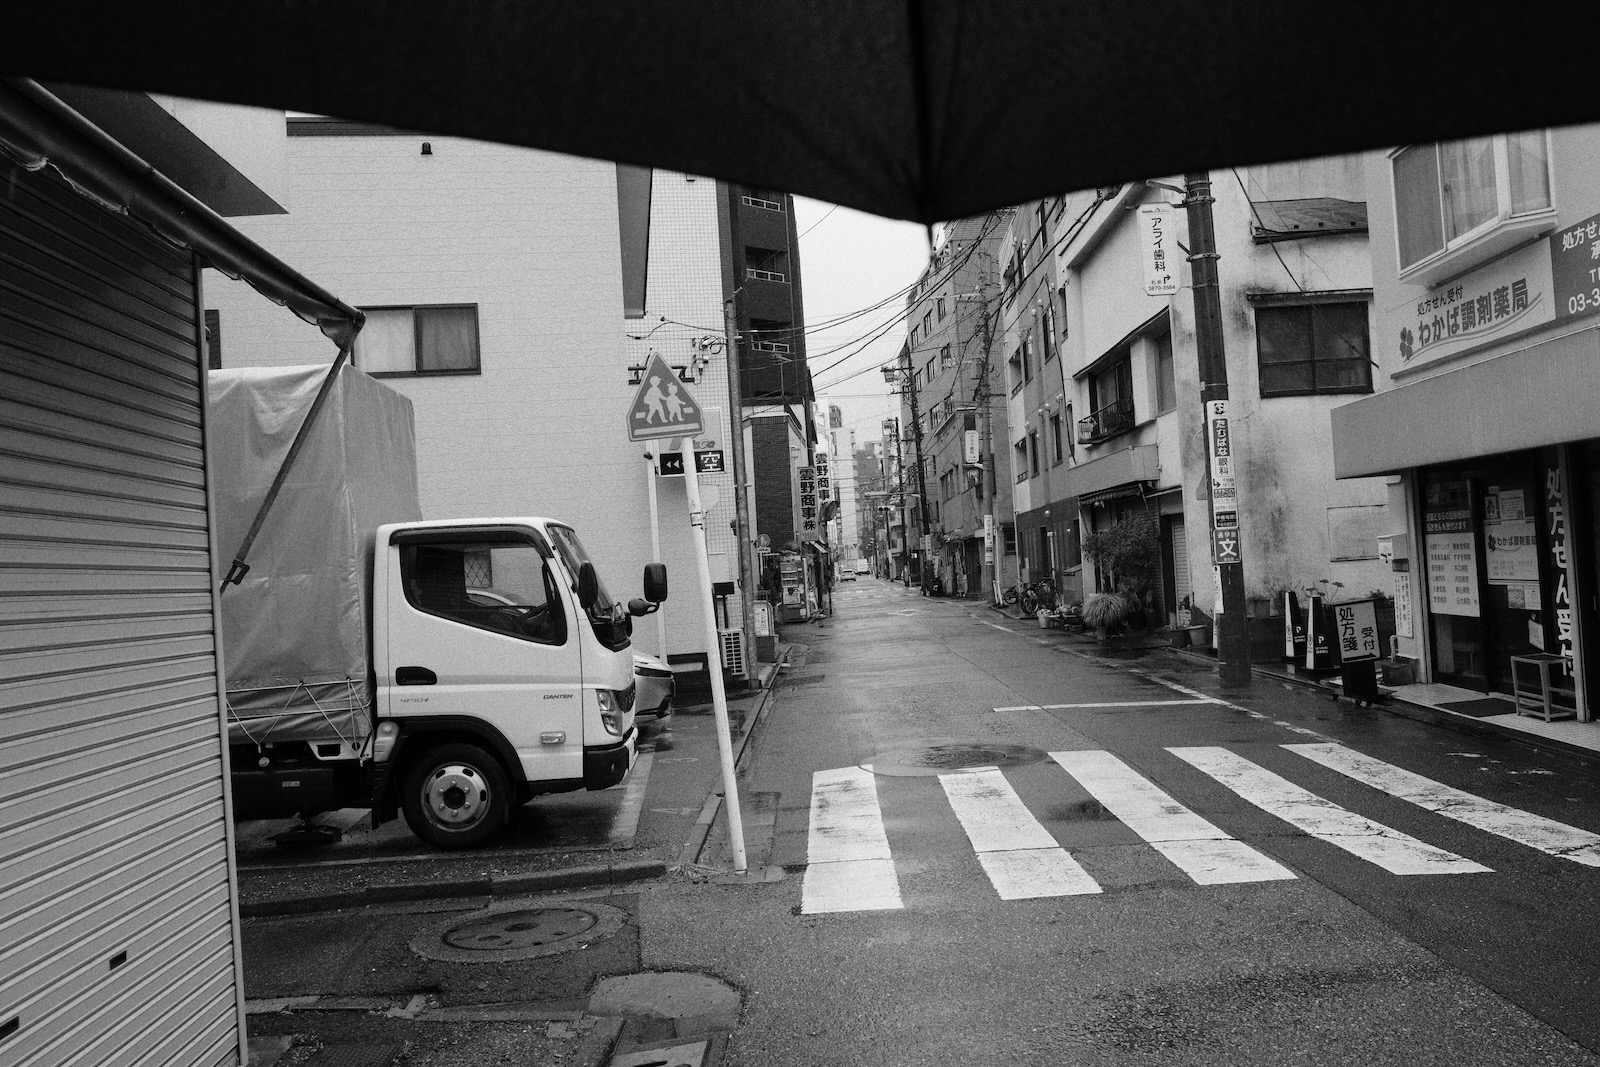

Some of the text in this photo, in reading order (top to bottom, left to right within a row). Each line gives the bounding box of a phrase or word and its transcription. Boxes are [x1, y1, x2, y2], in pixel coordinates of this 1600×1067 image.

[1151, 217, 1166, 272] アライ歯科
[1562, 220, 1600, 252] 処方せ
[1589, 266, 1600, 283] T
[1417, 284, 1463, 316] 処方せん受付
[1418, 277, 1529, 347] わかば調剤薬局
[1215, 420, 1228, 456] たちばな
[700, 451, 722, 472] 空
[1218, 457, 1229, 475] 眼科
[815, 453, 830, 506] 雲野商事
[1219, 538, 1238, 557] 文
[1497, 535, 1537, 546] わかば調剤薬局
[1339, 606, 1358, 652] 処方箋
[1361, 626, 1375, 651] 受付
